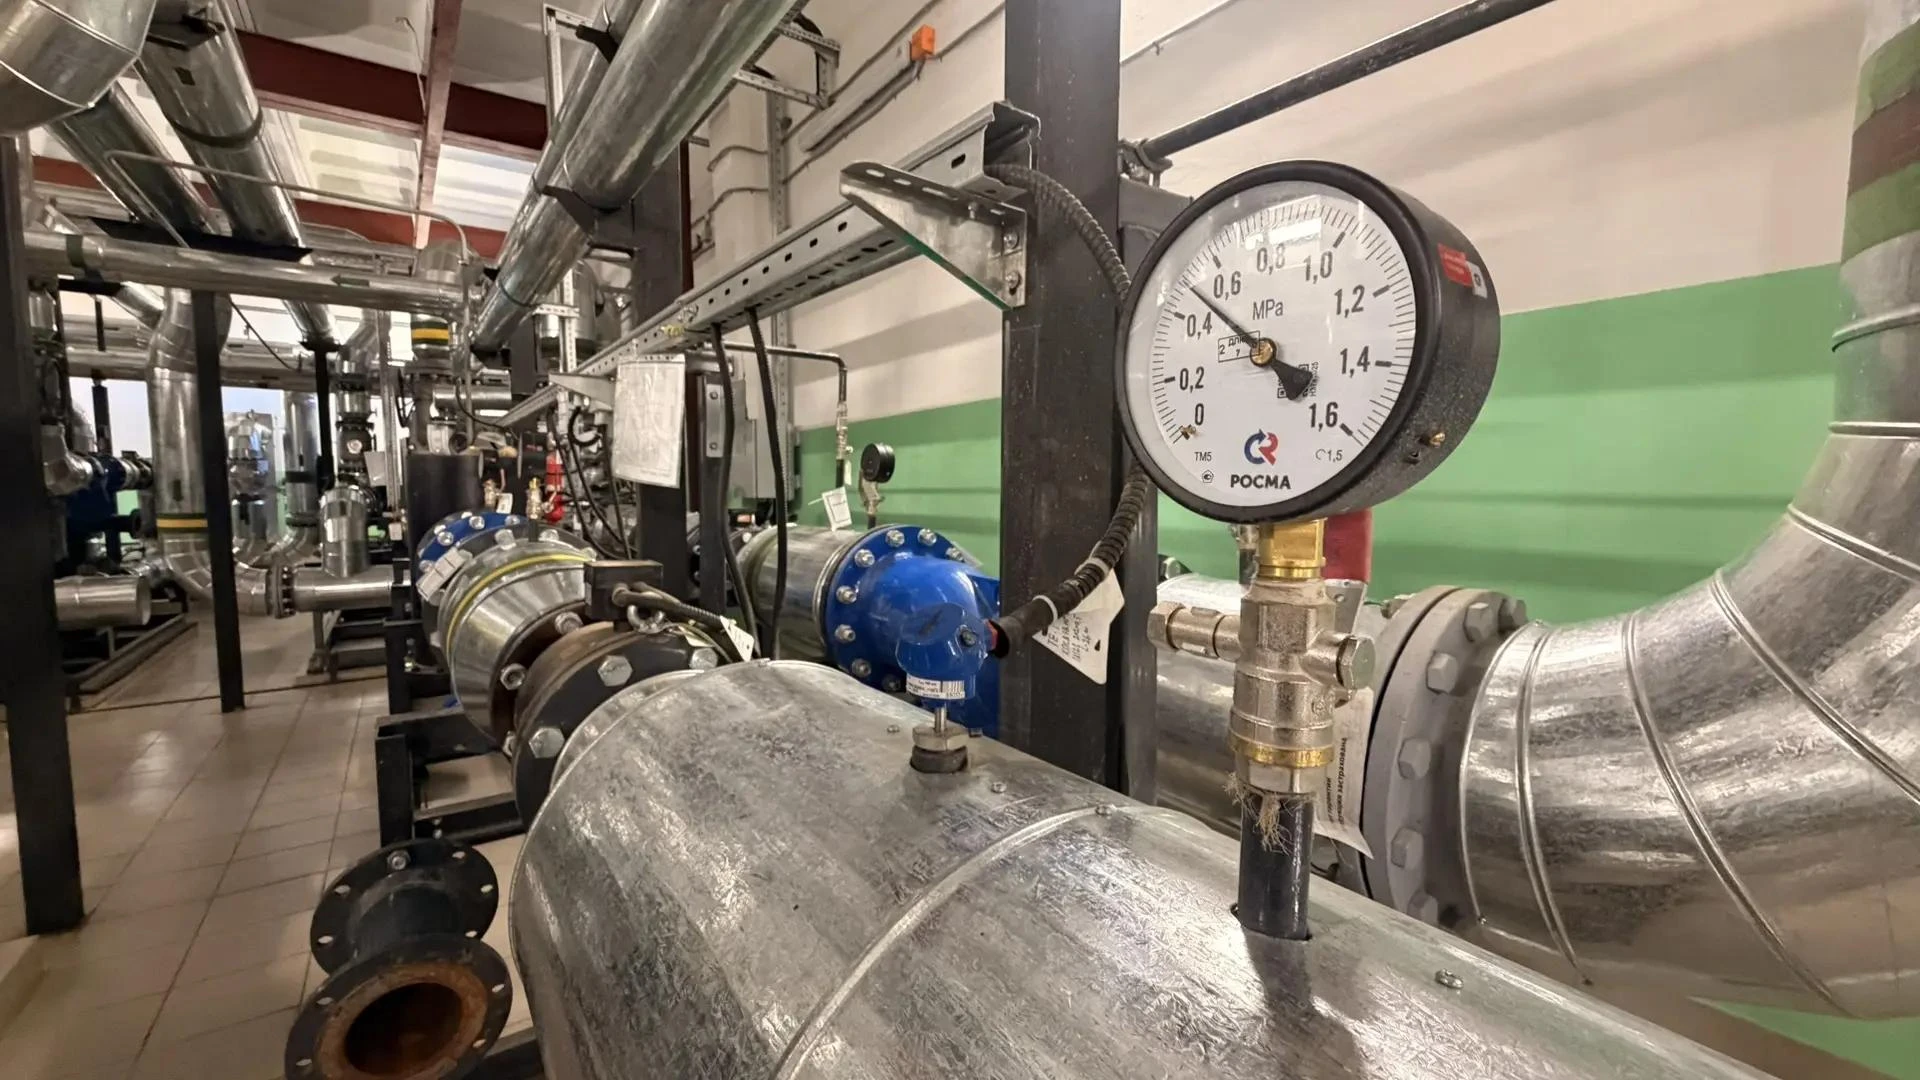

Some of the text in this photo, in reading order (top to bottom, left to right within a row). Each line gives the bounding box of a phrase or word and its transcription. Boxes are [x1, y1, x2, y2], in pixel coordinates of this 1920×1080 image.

[1256, 243, 1285, 275] 0,8
[1303, 251, 1333, 284] 1,0
[1213, 270, 1241, 300] 0,6
[1252, 299, 1284, 321] MPa
[1334, 284, 1365, 318] 1,2
[1186, 311, 1213, 340] 0,4
[1340, 345, 1370, 378] 1,4
[1179, 366, 1205, 393] 0,2
[1194, 403, 1205, 426] 0
[1308, 401, 1338, 431] 1,6
[1230, 474, 1291, 490] РОСМА
[1337, 737, 1348, 793] застрахована
